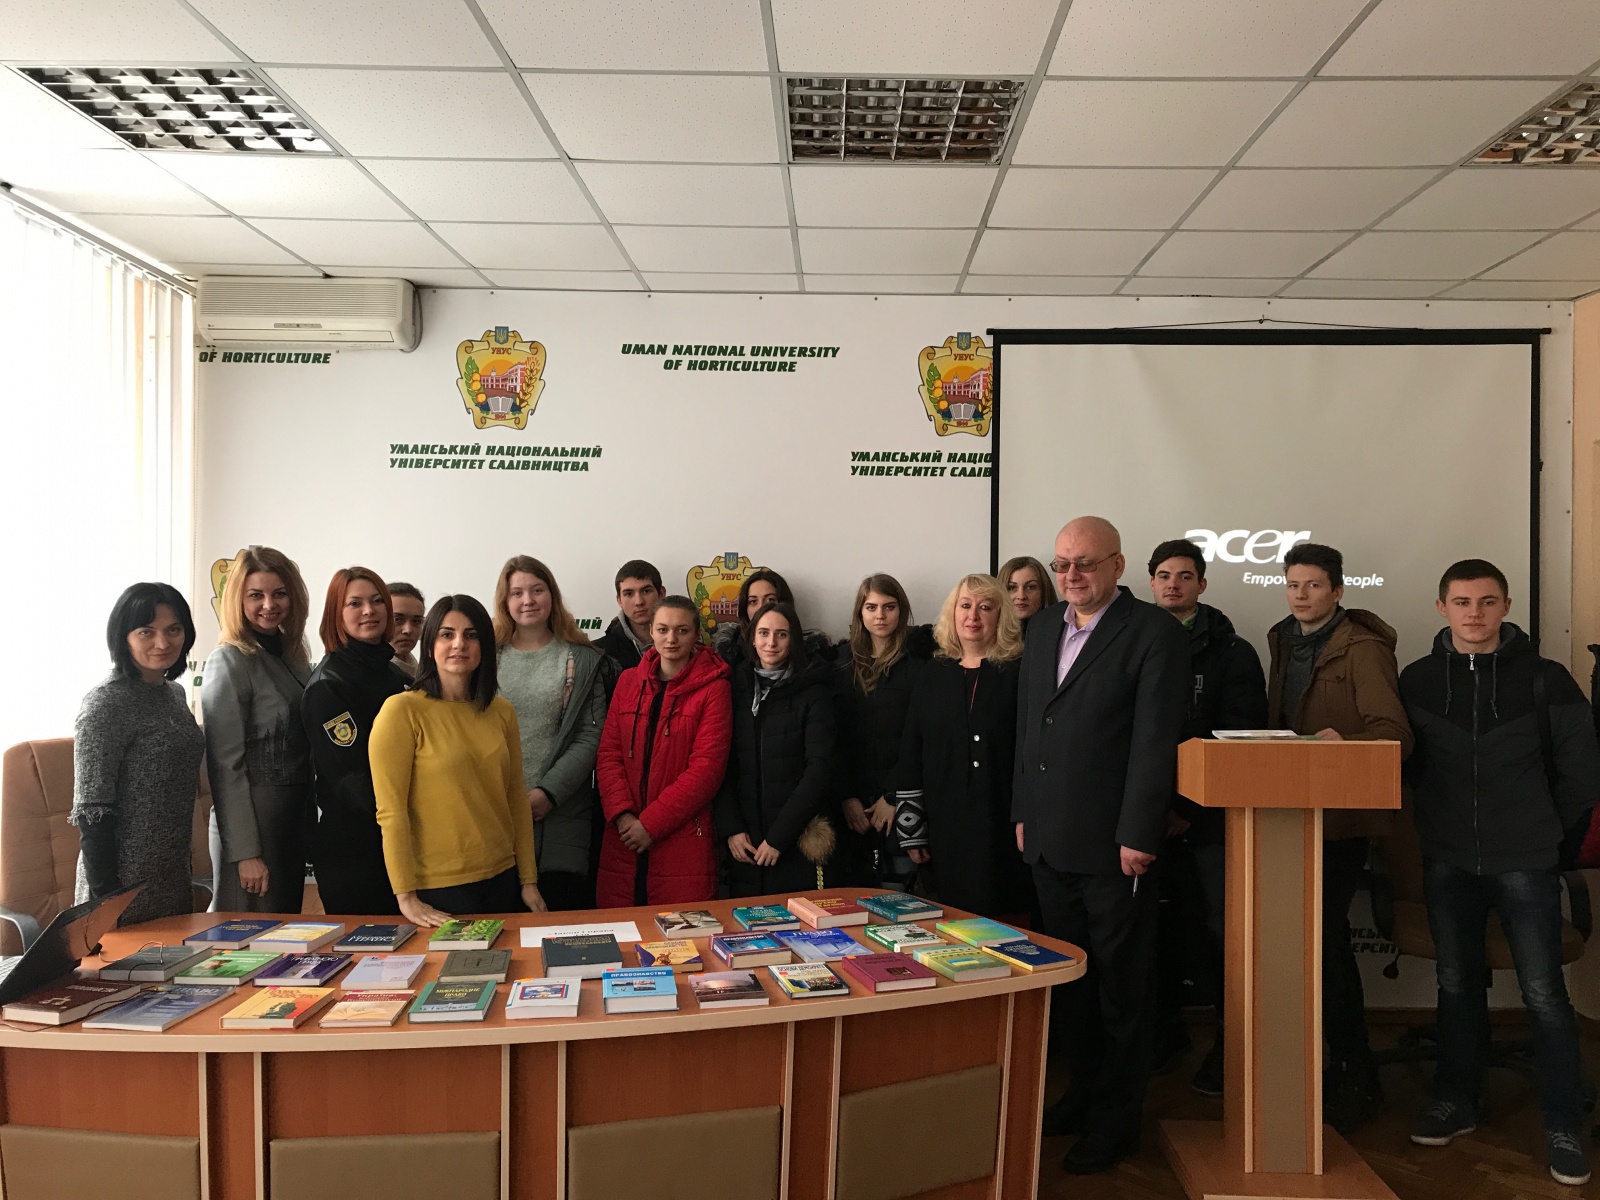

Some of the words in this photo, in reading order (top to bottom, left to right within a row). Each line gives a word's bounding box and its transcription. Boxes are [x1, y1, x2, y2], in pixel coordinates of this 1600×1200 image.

[491, 347, 512, 355] УНУС
[621, 343, 668, 355] UMAN
[672, 344, 746, 357] NATIONAL
[750, 346, 841, 358] UNIVERSITY
[953, 353, 975, 361] УНУС
[199, 351, 218, 363] OF
[221, 352, 331, 364] HORTICULTURE
[663, 359, 683, 371] OF
[686, 360, 797, 372] HORTICULTURE
[390, 442, 481, 456] УМАНСЬКИЙ
[485, 444, 603, 459] НАЦІОНАЛЬНИЙ
[850, 450, 943, 463] УМАНСЬКИЙ
[389, 458, 485, 470] УНІВЕРСИТЕТ
[488, 459, 589, 472] САДІВНИЦТВА
[850, 465, 947, 477] УНІВЕРСИТЕТ
[1184, 528, 1311, 564] acer
[721, 573, 742, 581] УНУС
[1342, 573, 1384, 589] eople
